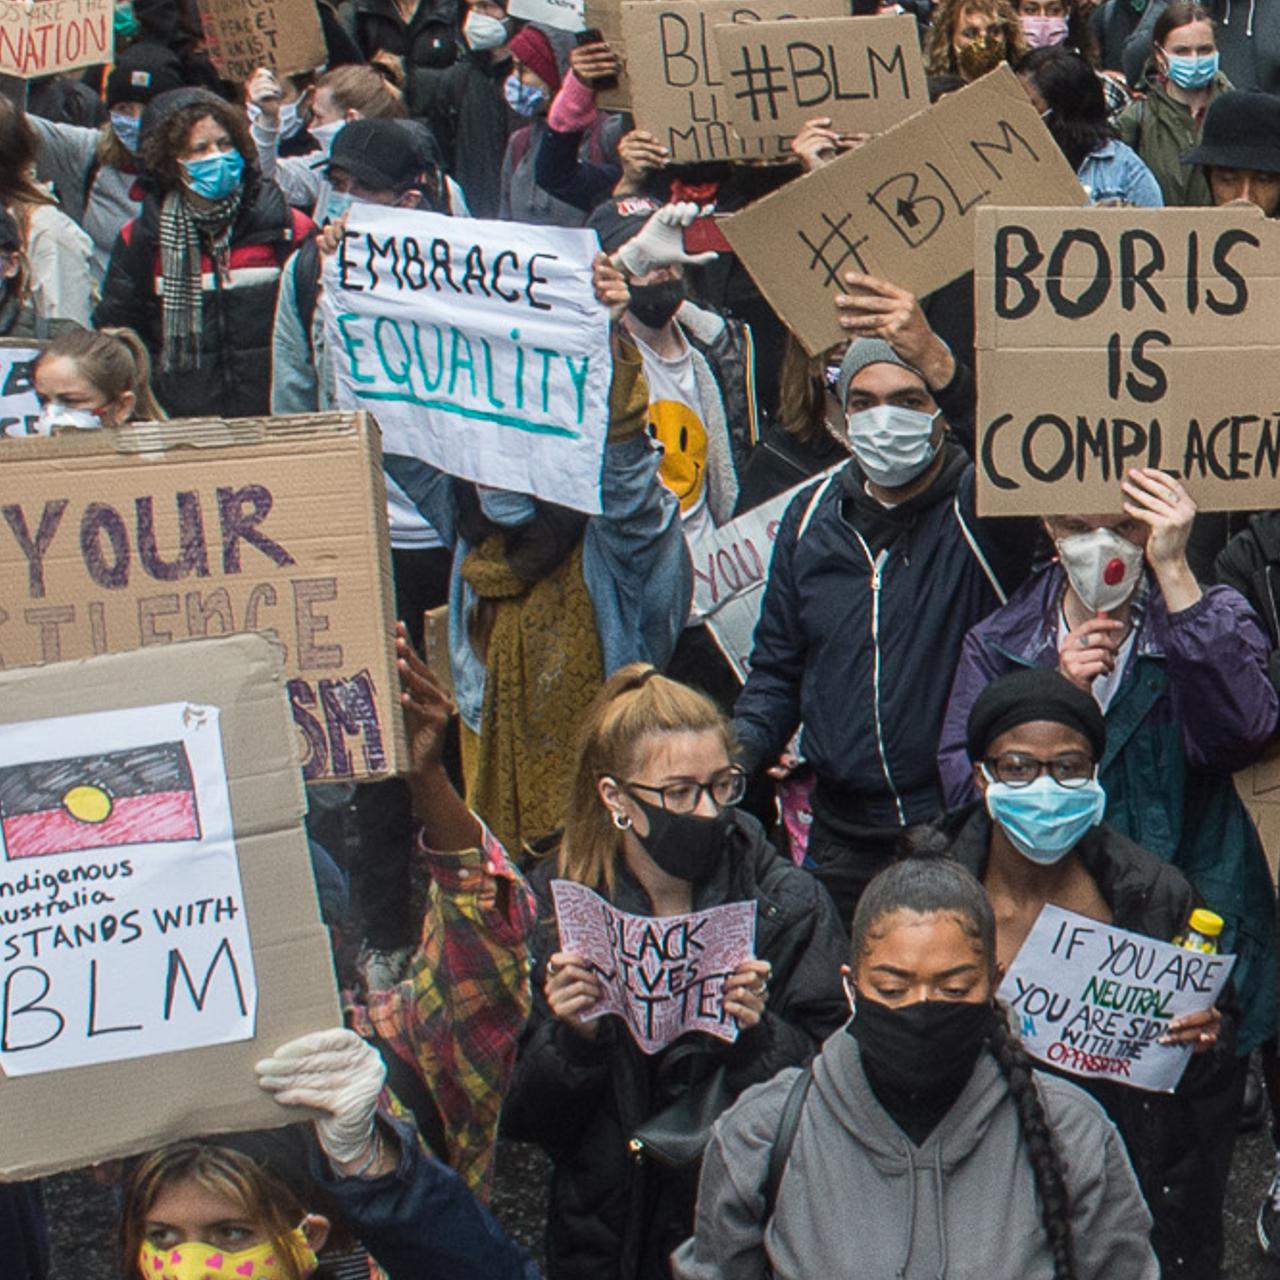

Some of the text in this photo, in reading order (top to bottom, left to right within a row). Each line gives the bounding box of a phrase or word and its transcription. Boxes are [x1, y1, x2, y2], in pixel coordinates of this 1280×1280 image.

[730, 42, 911, 122] #BLM
[339, 231, 560, 312] EMBRACE
[993, 223, 1261, 320] BORIS
[1106, 327, 1173, 405] IS
[2, 484, 297, 599] YOUR
[4, 895, 239, 961] STANDS WITH
[603, 904, 708, 961] BLACK
[1051, 921, 1223, 993] IF YOU ARE
[1, 937, 248, 1053] BLM
[1011, 977, 1124, 1036] YOU ARE
[1081, 975, 1175, 1019] NEUTRAL
[1061, 1027, 1149, 1060] WITH THE
